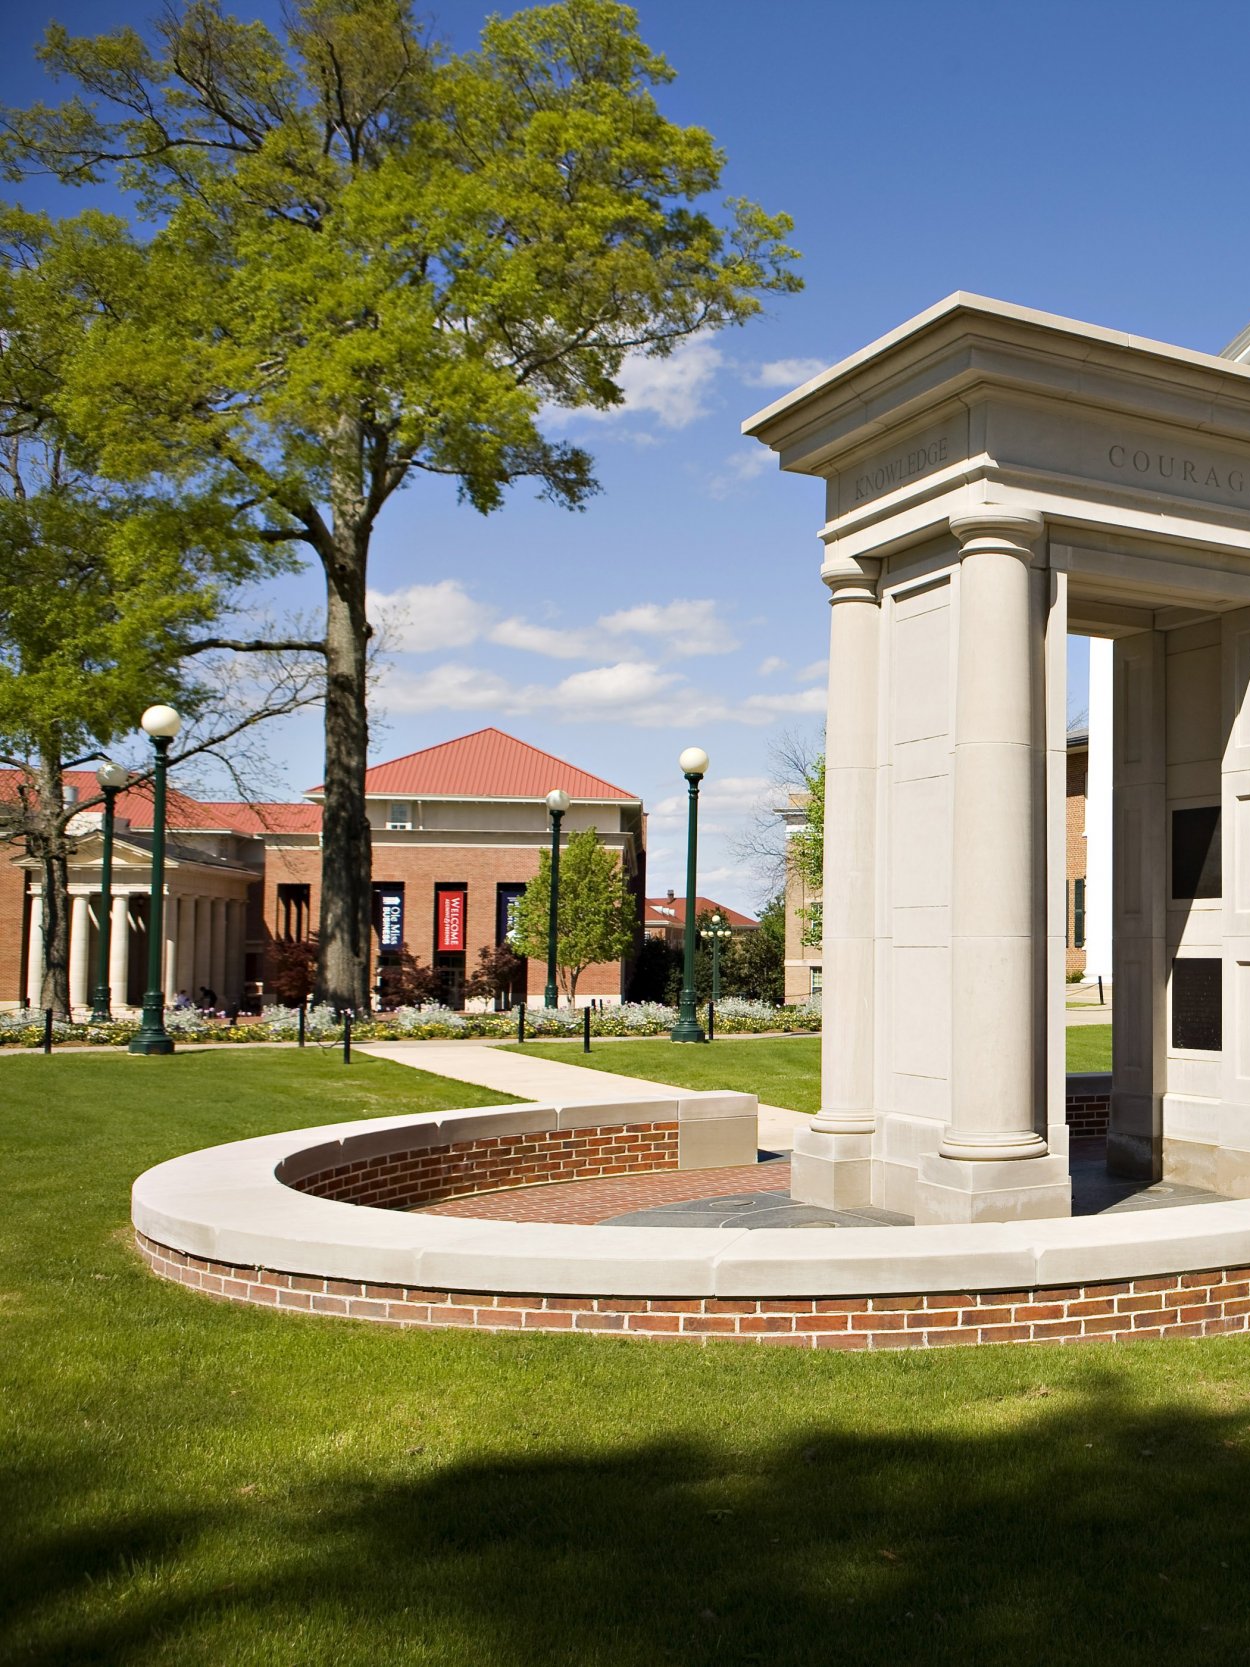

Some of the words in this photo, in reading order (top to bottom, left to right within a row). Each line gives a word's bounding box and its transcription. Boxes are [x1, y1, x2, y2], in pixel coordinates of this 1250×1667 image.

[855, 437, 948, 500] KNOWLEDGE
[382, 906, 391, 945] BUSINESS
[391, 906, 400, 922] Ole
[450, 897, 460, 945] WELCOME
[390, 924, 400, 945] Miss
